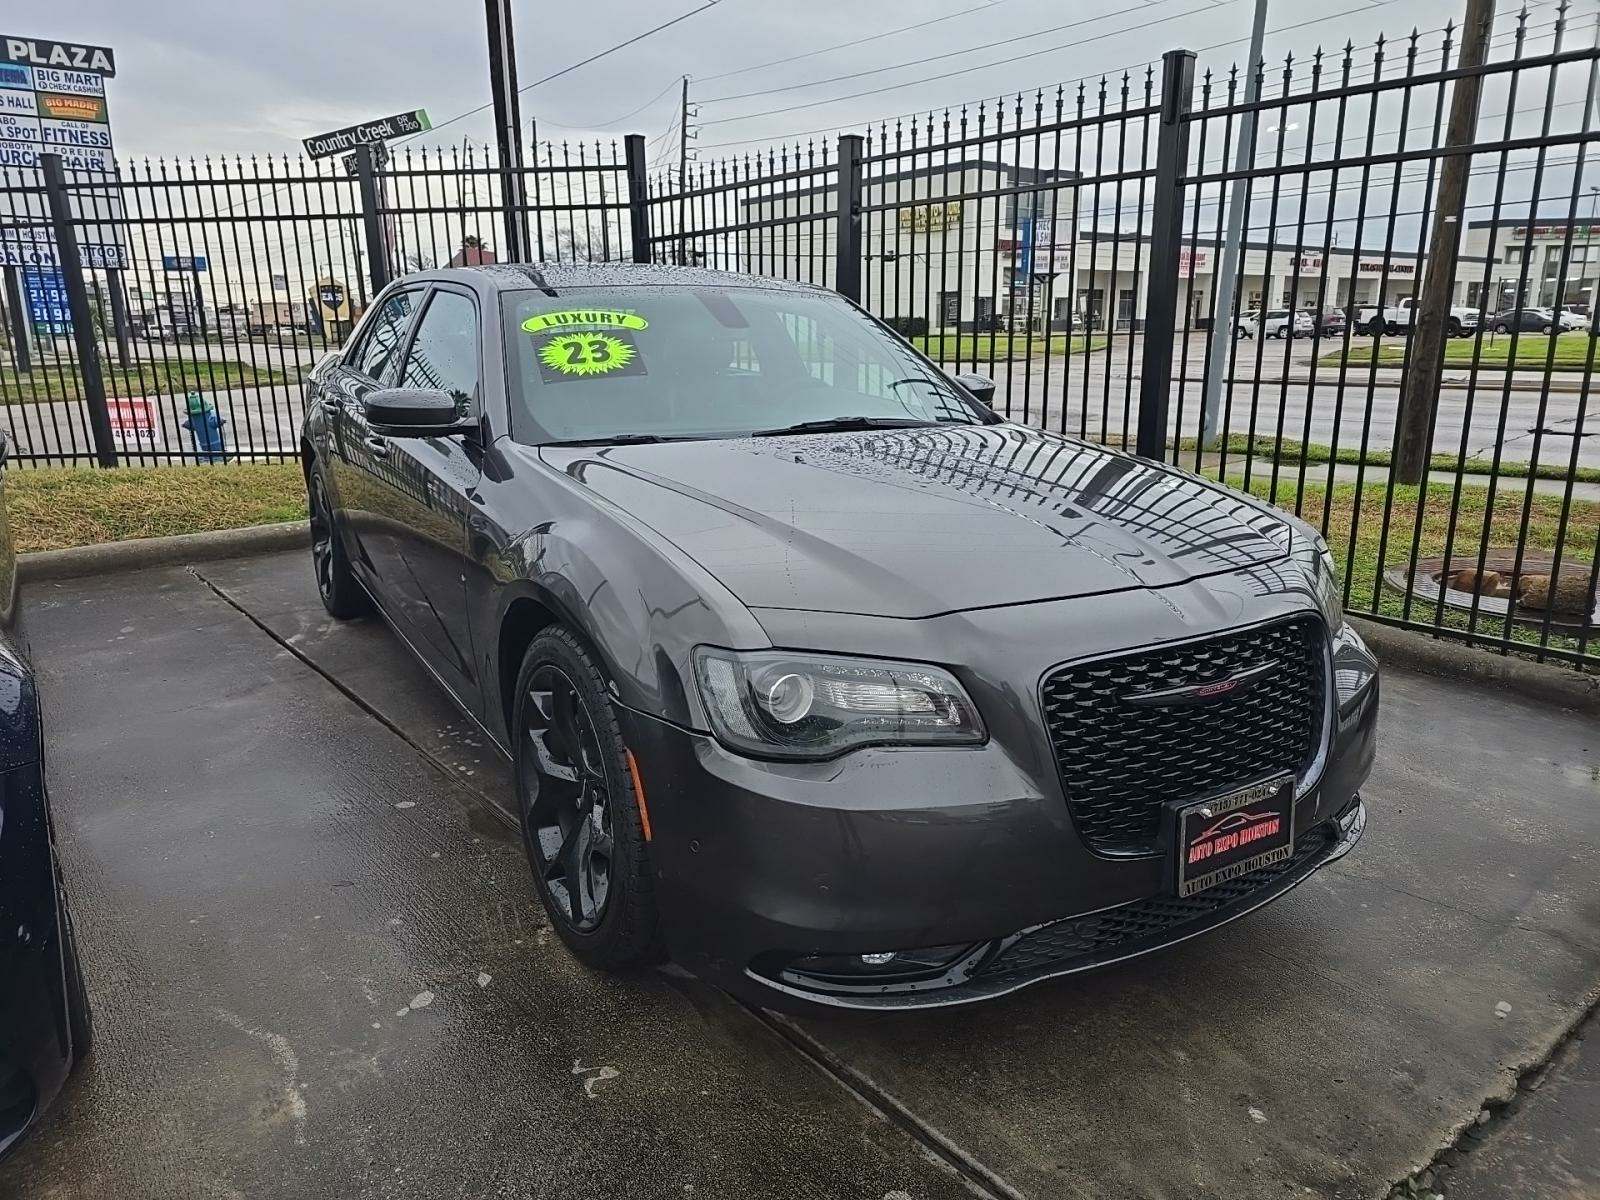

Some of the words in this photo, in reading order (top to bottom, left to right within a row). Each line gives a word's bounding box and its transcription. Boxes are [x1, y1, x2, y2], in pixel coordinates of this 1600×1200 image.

[6, 39, 112, 71] PLAZA
[37, 69, 60, 82] BIG
[64, 72, 101, 86] MART
[49, 82, 71, 91] CHECK
[73, 84, 104, 95] CASHING
[7, 96, 34, 109] HALL
[61, 121, 78, 129] CALL
[397, 114, 408, 125] DR
[400, 120, 419, 132] 7300
[7, 126, 37, 140] SPOT
[43, 126, 109, 146] FITNESS
[306, 131, 357, 156] Country
[356, 119, 396, 142] Creek
[53, 146, 104, 157] FOREIGN
[22, 229, 56, 240] HOUSTN
[542, 312, 628, 327] LUXURY
[562, 339, 611, 365] 23
[1188, 841, 1213, 864] AUTO
[1214, 832, 1238, 855] EXPO
[1184, 875, 1212, 896] AUTO
[1215, 864, 1242, 883] EXPO
[1243, 846, 1292, 874] HOUSTON
